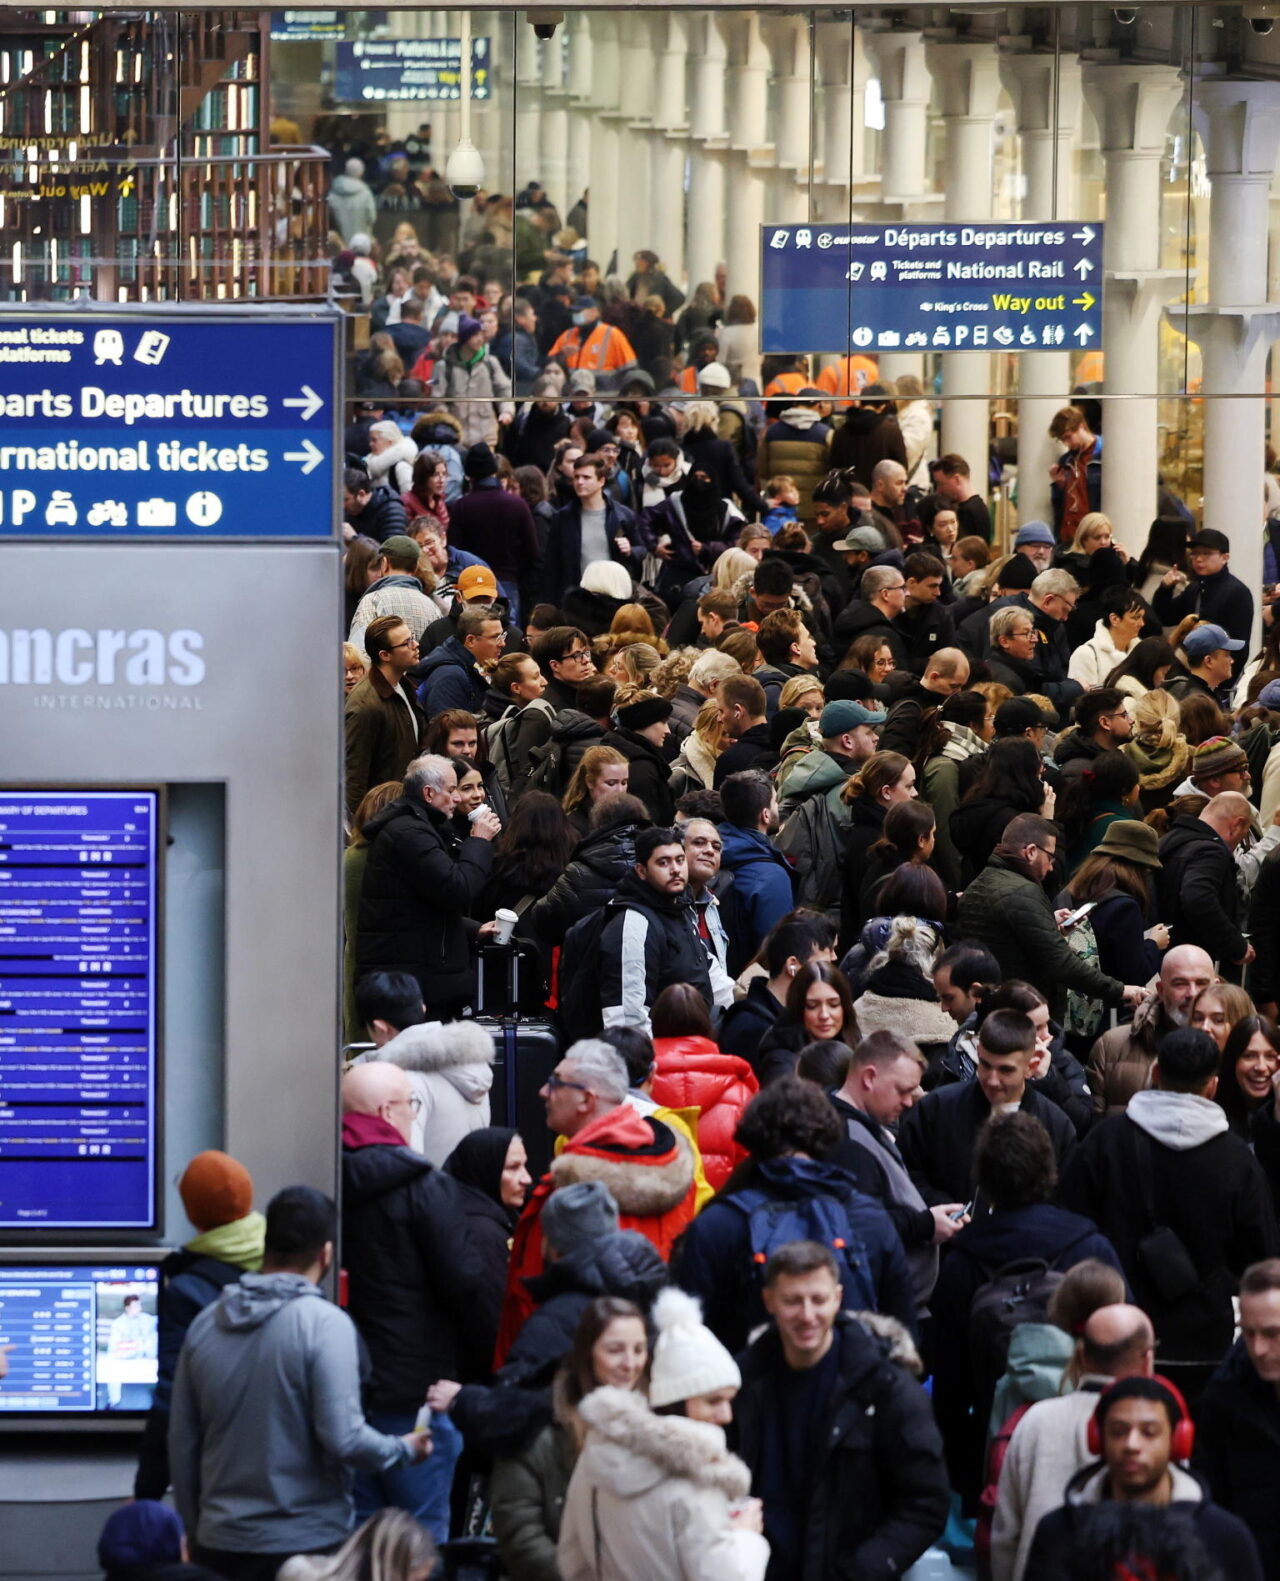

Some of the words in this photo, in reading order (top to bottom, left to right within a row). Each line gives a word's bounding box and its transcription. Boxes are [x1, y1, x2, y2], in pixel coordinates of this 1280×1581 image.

[884, 229, 957, 251] Départs
[961, 229, 1065, 250] Departures
[892, 260, 922, 270] Tickets
[922, 260, 942, 269] and
[947, 261, 1024, 279] National
[1028, 261, 1065, 278] Rail
[898, 270, 942, 281] platforms
[934, 303, 962, 314] King's
[962, 302, 989, 312] Cross
[992, 295, 1032, 314] Way
[1034, 295, 1065, 311] out
[30, 328, 84, 345] tickets
[81, 386, 269, 425] Departures
[157, 440, 269, 472] tickets
[34, 694, 204, 711] INTERNATIONAL
